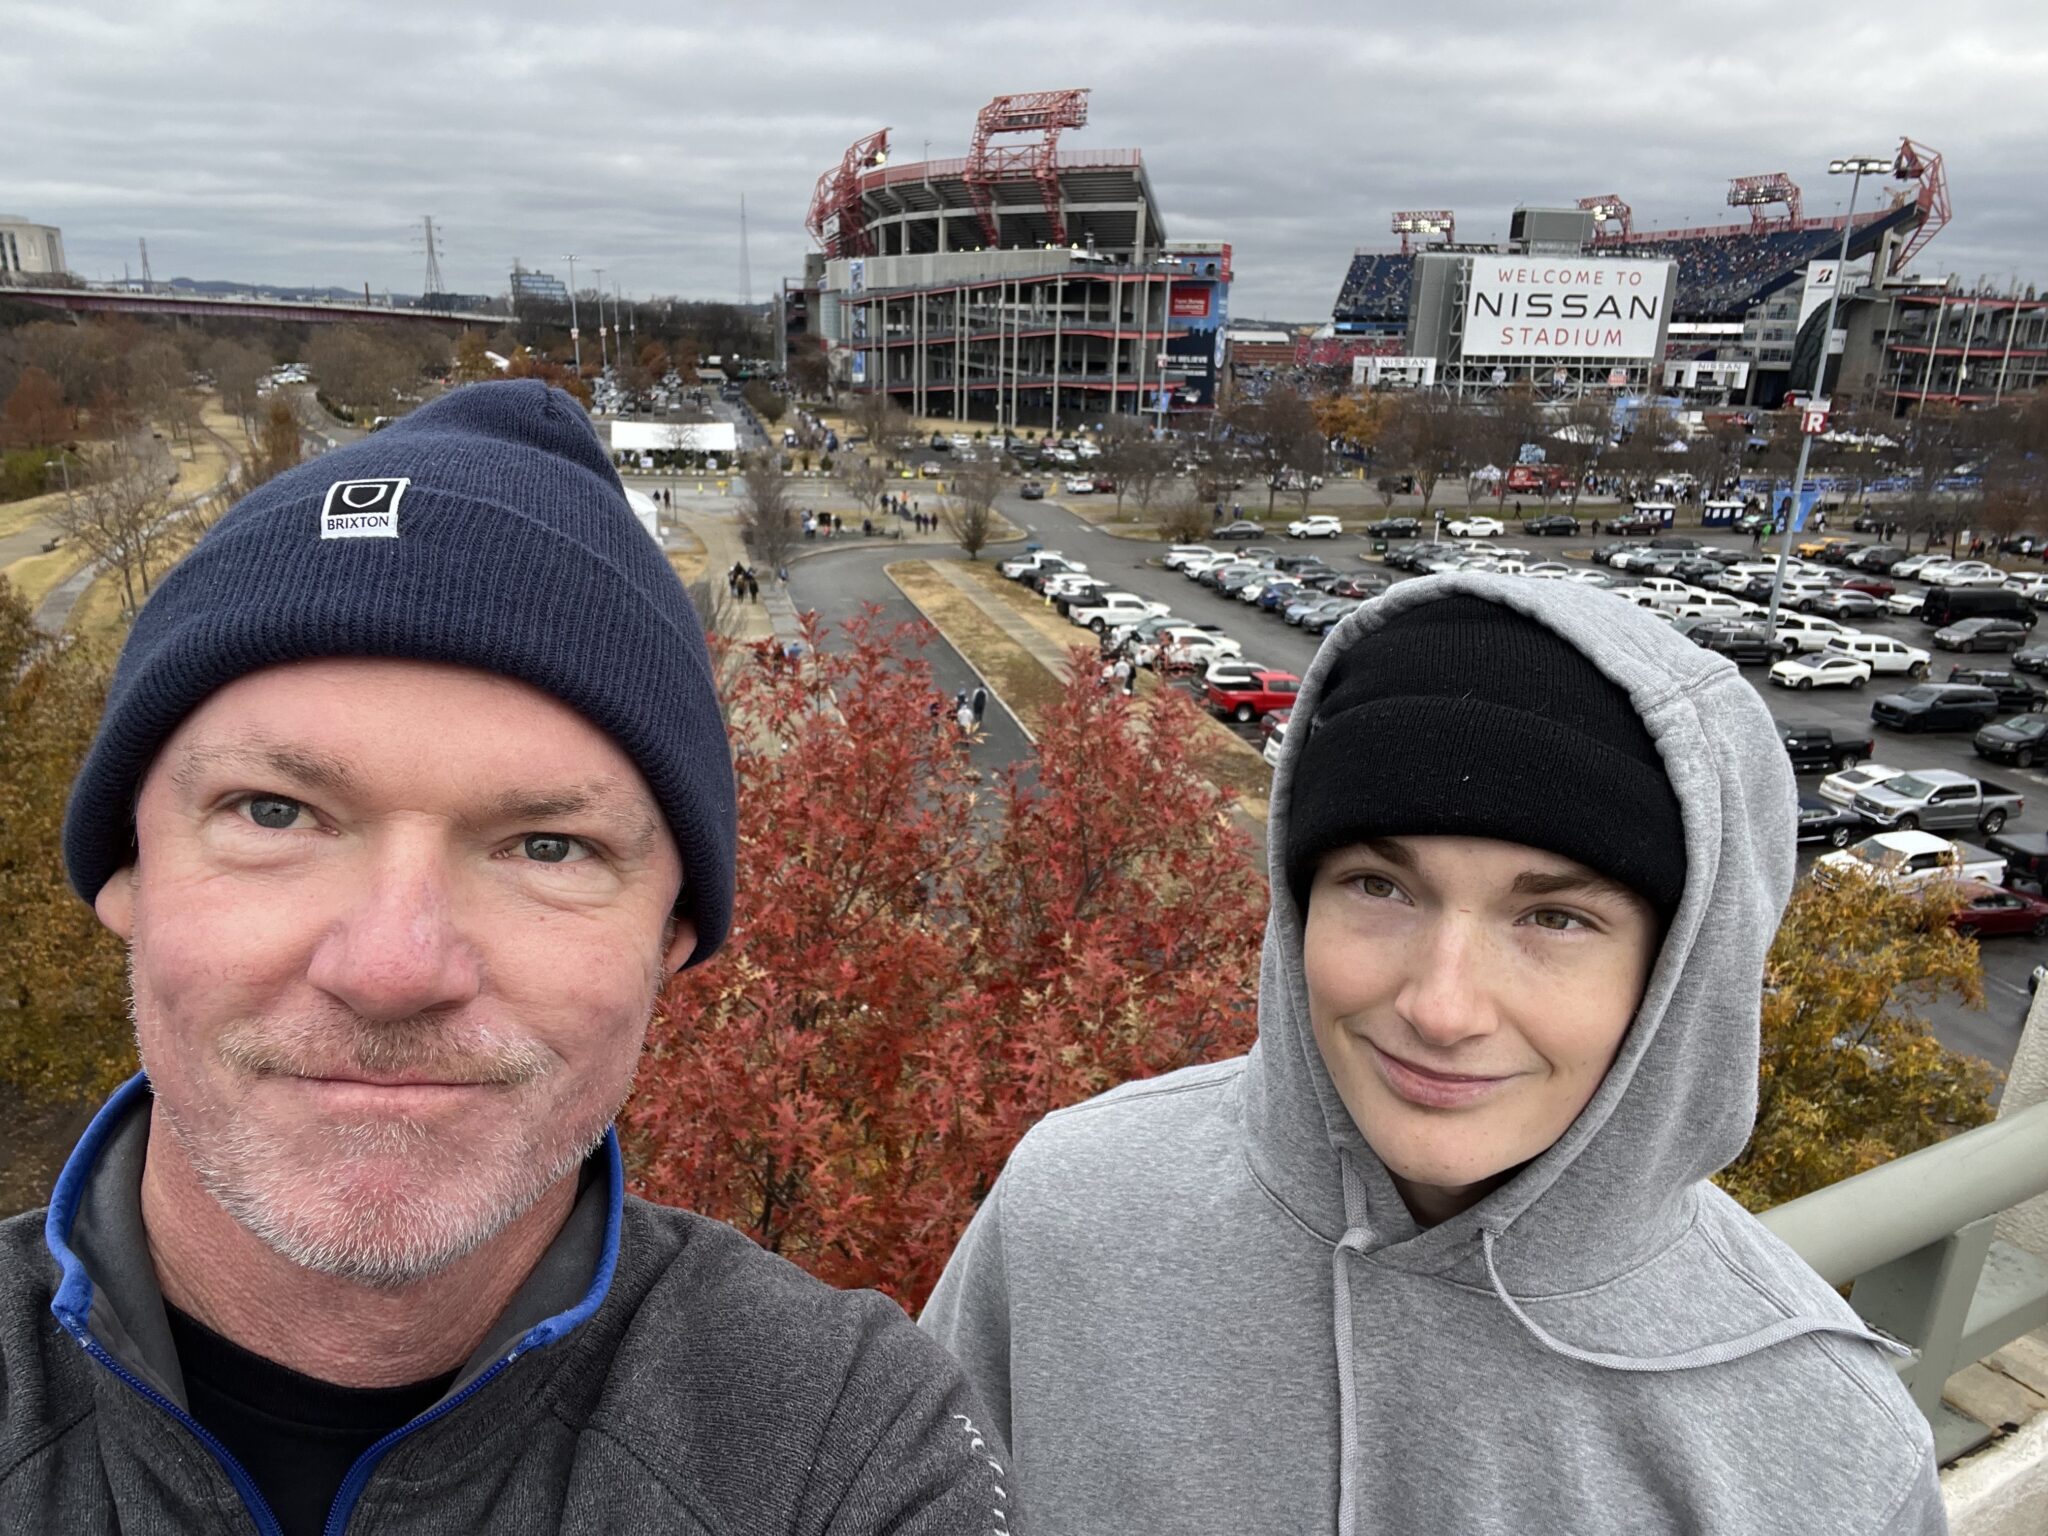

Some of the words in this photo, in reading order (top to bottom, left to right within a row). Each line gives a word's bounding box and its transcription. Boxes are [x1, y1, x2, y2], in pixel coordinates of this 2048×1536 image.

[1498, 268, 1604, 284] WELCOME
[1616, 271, 1642, 286] TO
[1474, 292, 1658, 320] NISSAN
[1500, 327, 1622, 347] STADIUM
[1381, 359, 1428, 367] NISSAN
[1699, 362, 1741, 370] NISSAN
[1807, 413, 1824, 432] R
[327, 516, 389, 531] BRIXTON
